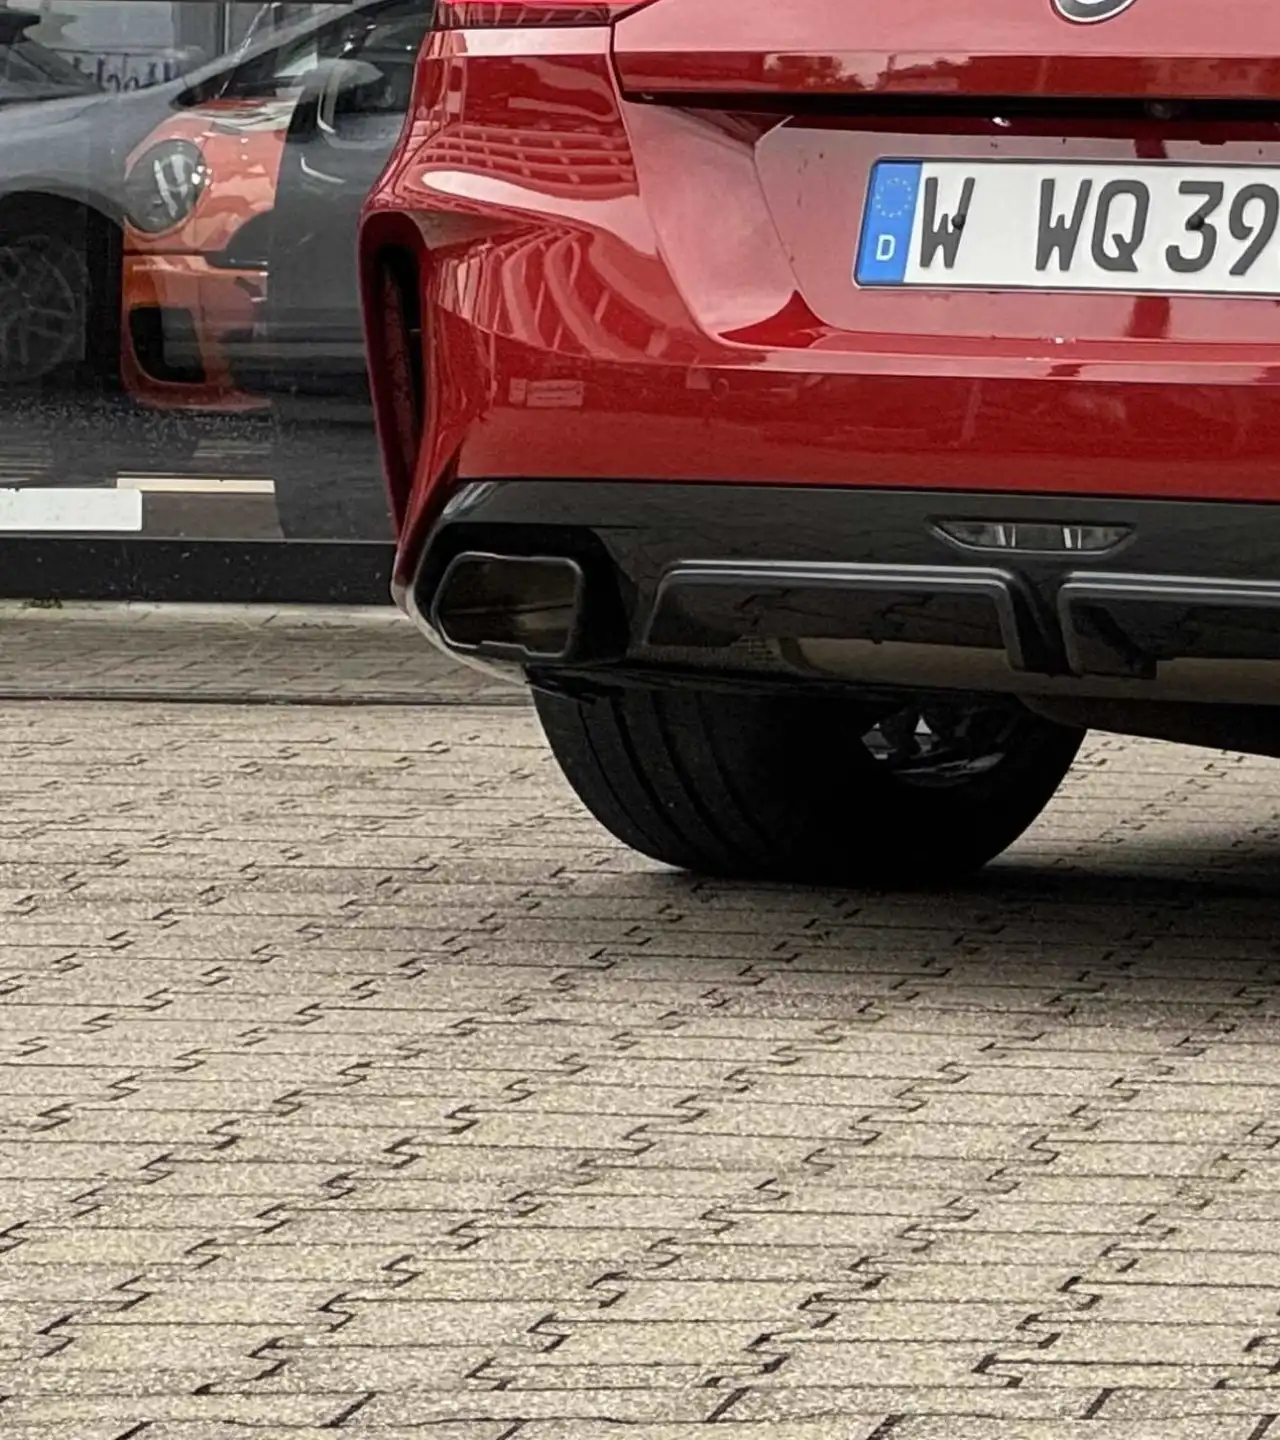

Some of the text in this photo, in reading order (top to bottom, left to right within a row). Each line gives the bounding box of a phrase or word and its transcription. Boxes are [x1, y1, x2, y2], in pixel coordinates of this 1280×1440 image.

[876, 233, 896, 261] D
[919, 176, 976, 269] W
[1034, 177, 1151, 273] WQ
